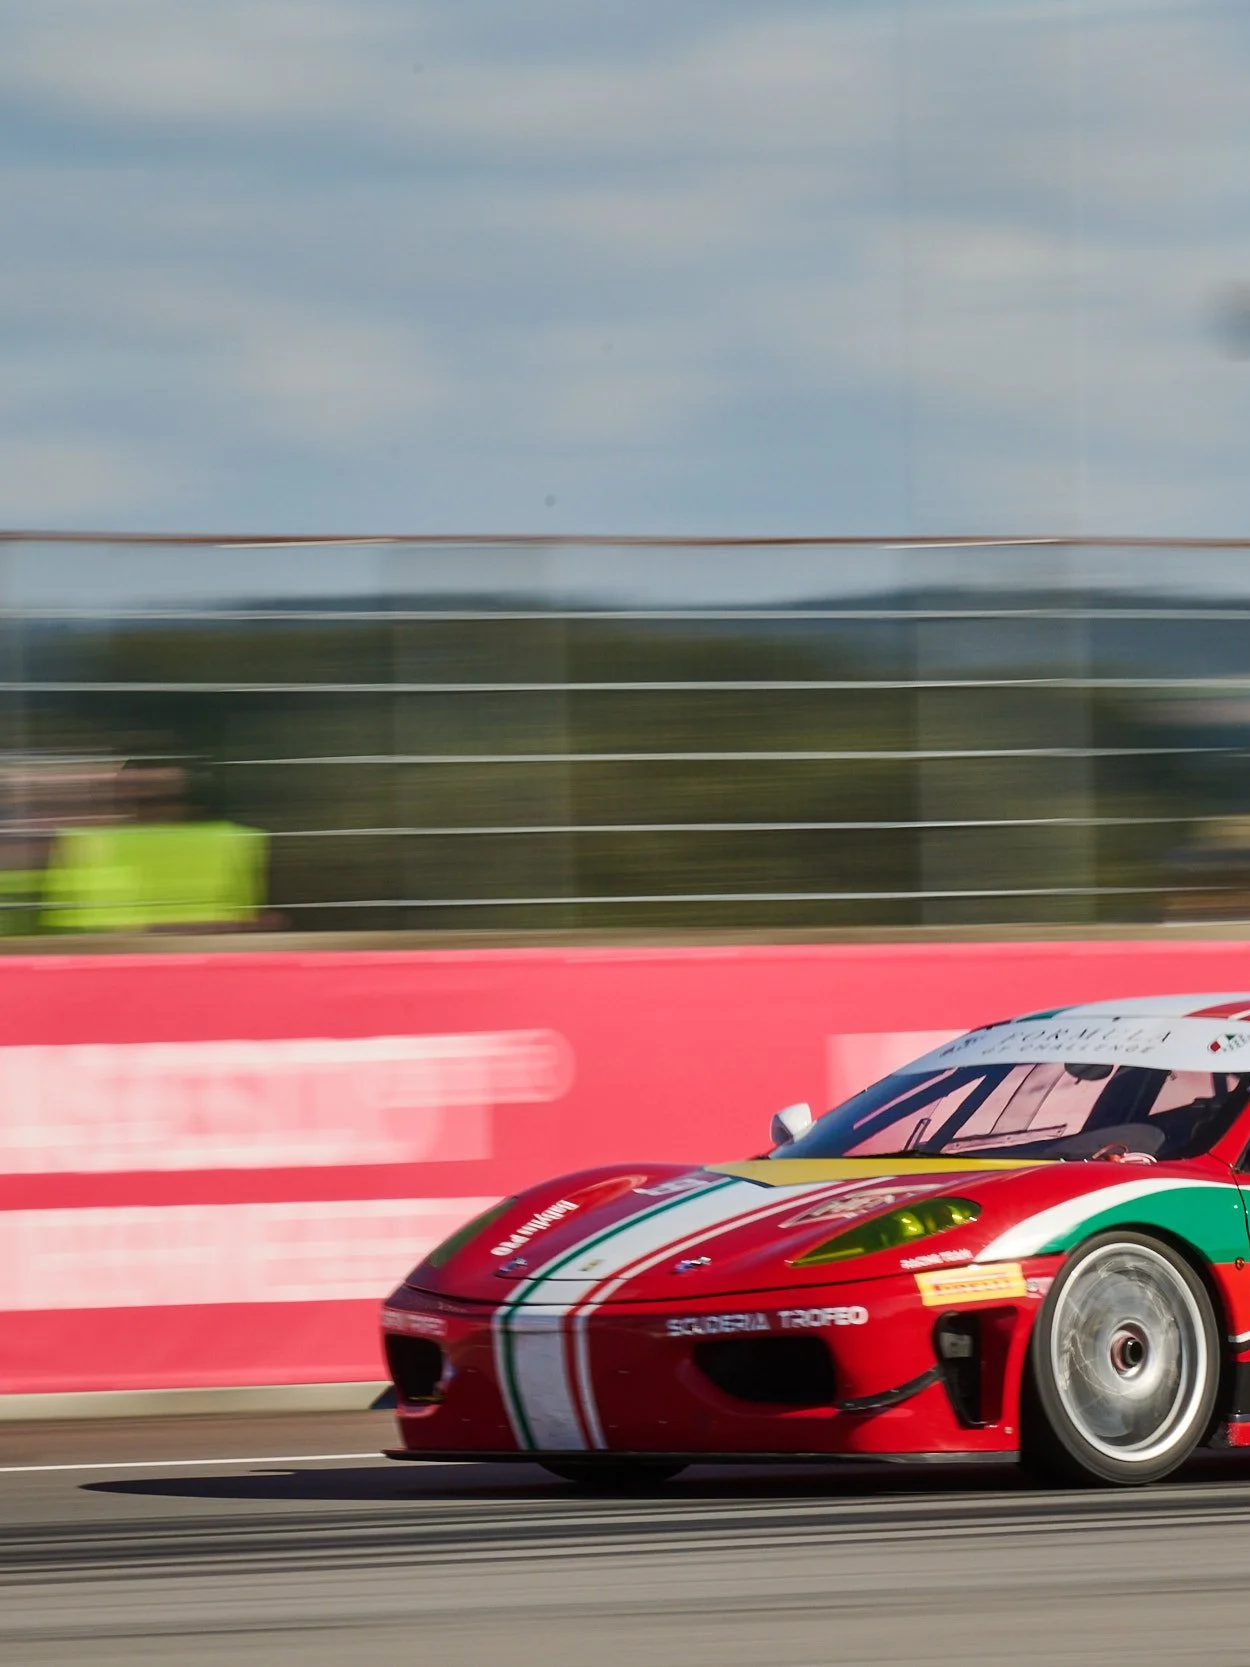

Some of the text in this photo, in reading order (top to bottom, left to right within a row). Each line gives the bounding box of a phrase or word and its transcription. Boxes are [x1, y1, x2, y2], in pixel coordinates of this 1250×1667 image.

[1000, 1029, 1172, 1043] FORMULA
[490, 1233, 530, 1256] PRO
[777, 1305, 869, 1329] TROFEO
